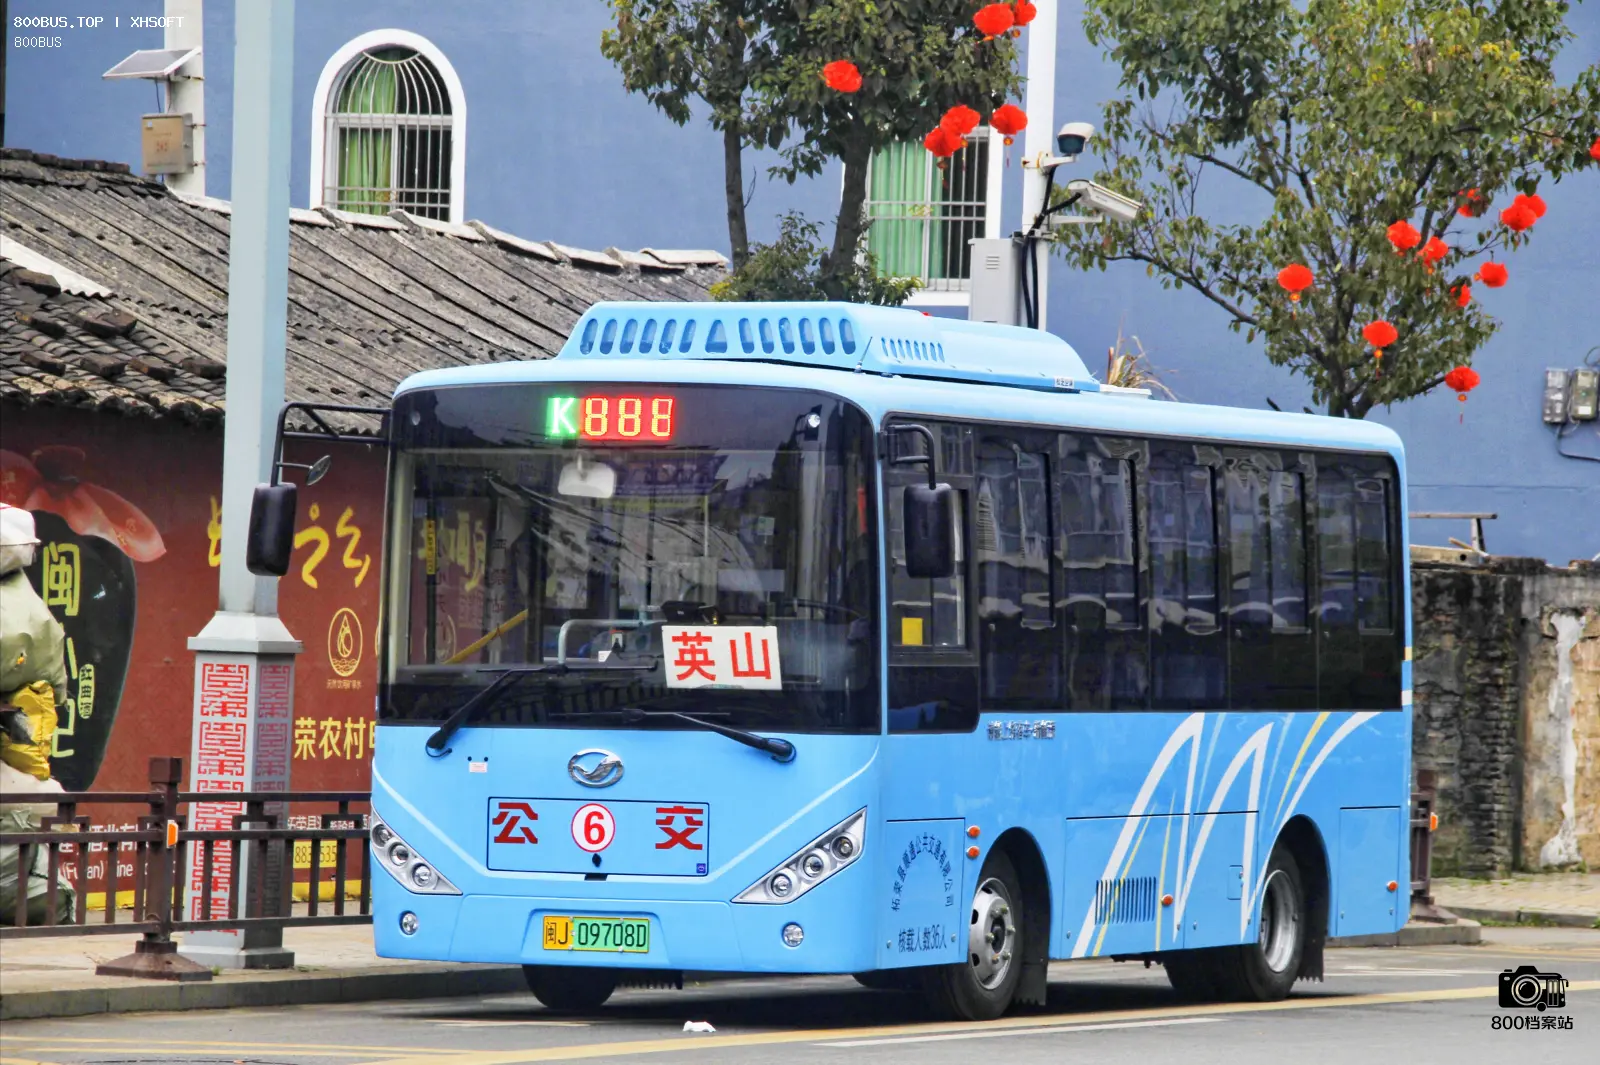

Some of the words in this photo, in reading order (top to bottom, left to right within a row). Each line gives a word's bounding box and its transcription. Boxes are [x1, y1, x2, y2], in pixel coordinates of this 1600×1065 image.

[671, 630, 772, 682] 英山
[492, 802, 538, 844] 公
[583, 811, 606, 845] 6
[655, 806, 703, 850] 交
